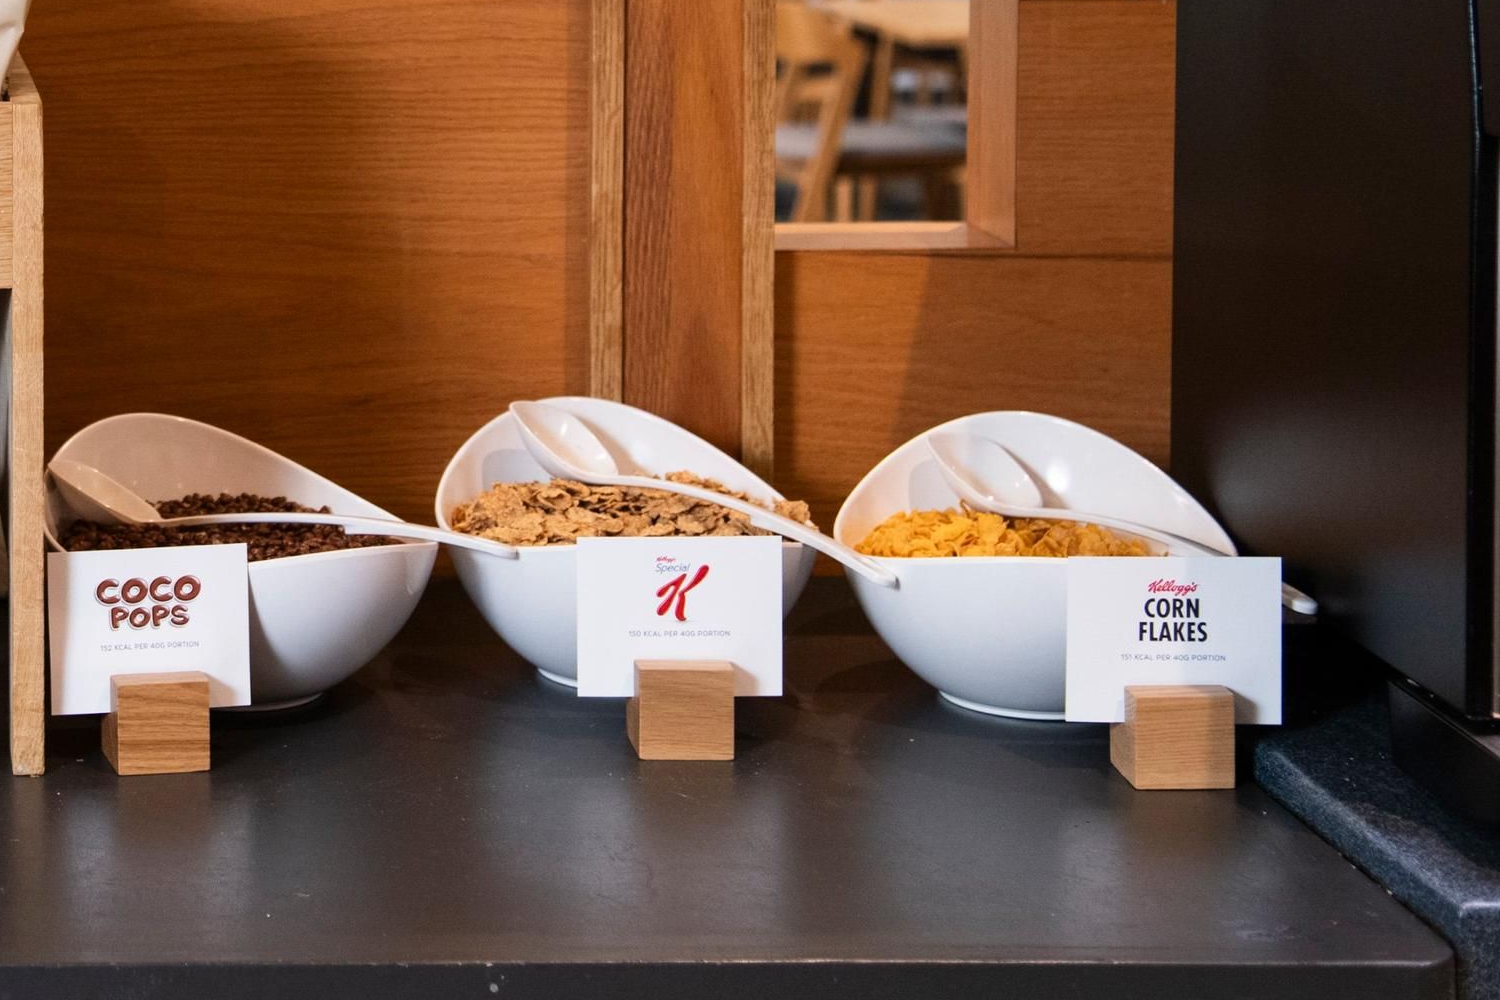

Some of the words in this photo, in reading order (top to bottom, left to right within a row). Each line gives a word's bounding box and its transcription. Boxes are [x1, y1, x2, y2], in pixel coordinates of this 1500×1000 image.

[655, 563, 691, 574] Special
[95, 574, 202, 605] COCO
[656, 564, 710, 622] K
[1148, 579, 1199, 596] Kellogg's
[110, 603, 190, 631] POPS
[1144, 598, 1200, 618] CORN
[1139, 621, 1208, 642] FLAKES
[114, 643, 133, 651] KCAL
[167, 640, 200, 648] PORTION
